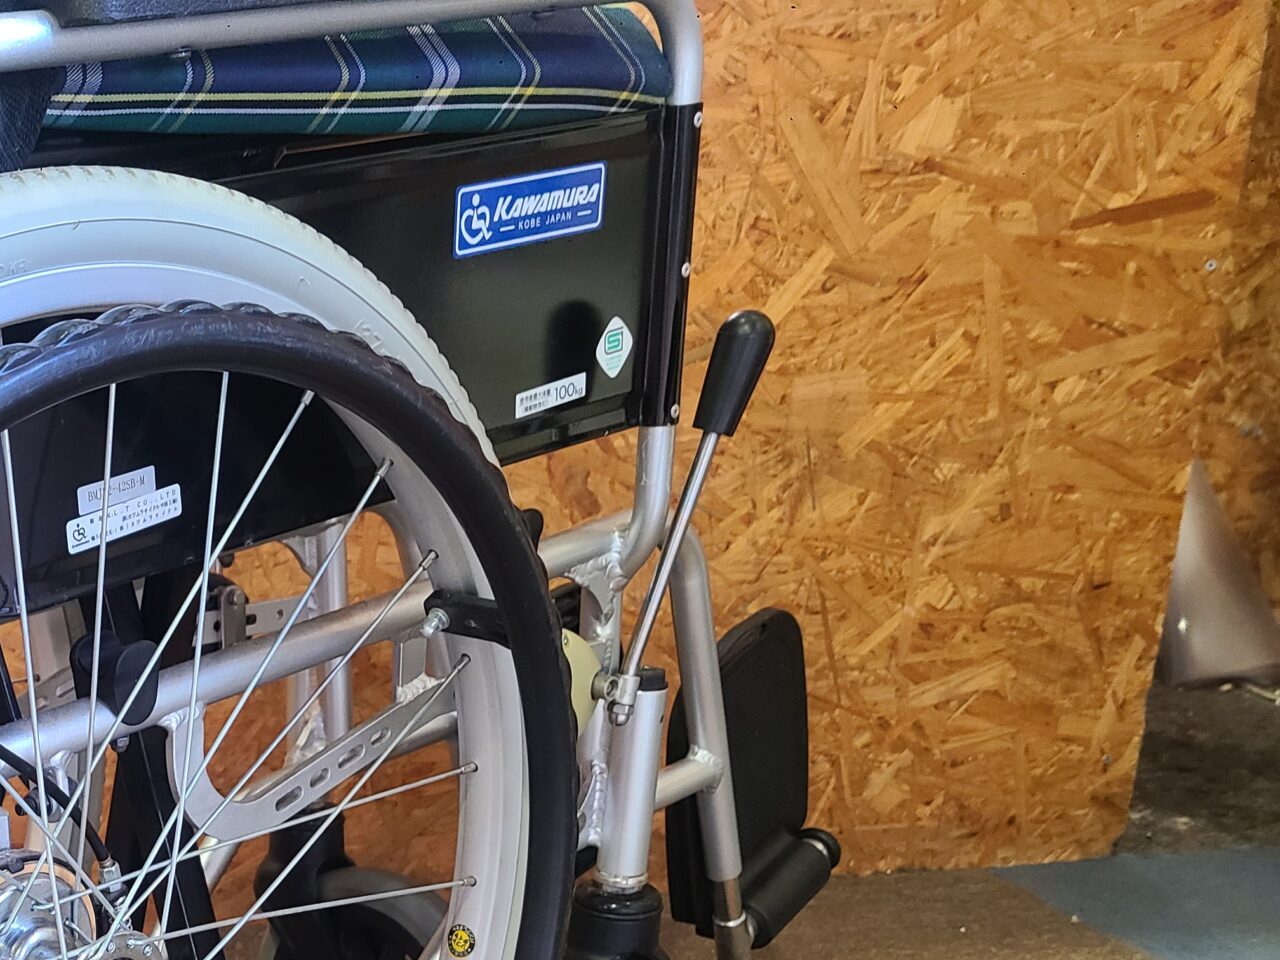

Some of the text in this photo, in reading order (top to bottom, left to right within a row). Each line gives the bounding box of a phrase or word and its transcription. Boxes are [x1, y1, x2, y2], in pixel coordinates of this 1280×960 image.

[493, 182, 600, 222] KAWAMURA
[518, 210, 572, 230] KOBE JAPAN
